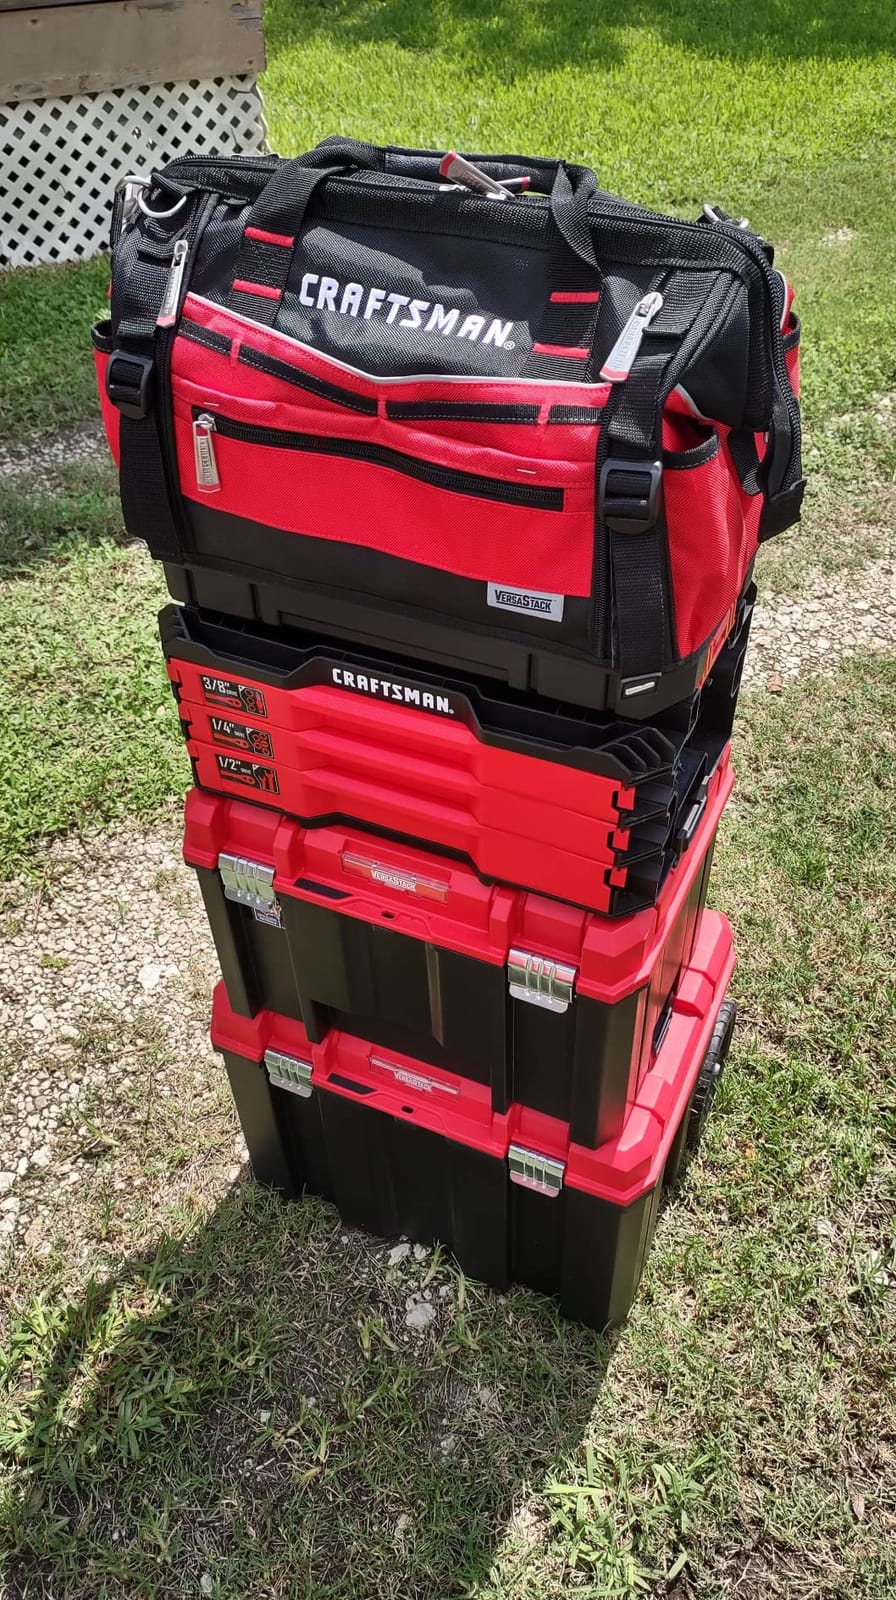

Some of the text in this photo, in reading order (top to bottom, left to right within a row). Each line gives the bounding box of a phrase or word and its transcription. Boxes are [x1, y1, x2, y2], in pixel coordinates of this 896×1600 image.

[203, 676, 230, 694] 3/8"
[332, 668, 449, 713] CRAFTSMAN
[211, 718, 235, 734] 1/4"
[218, 755, 241, 771] 1/2"
